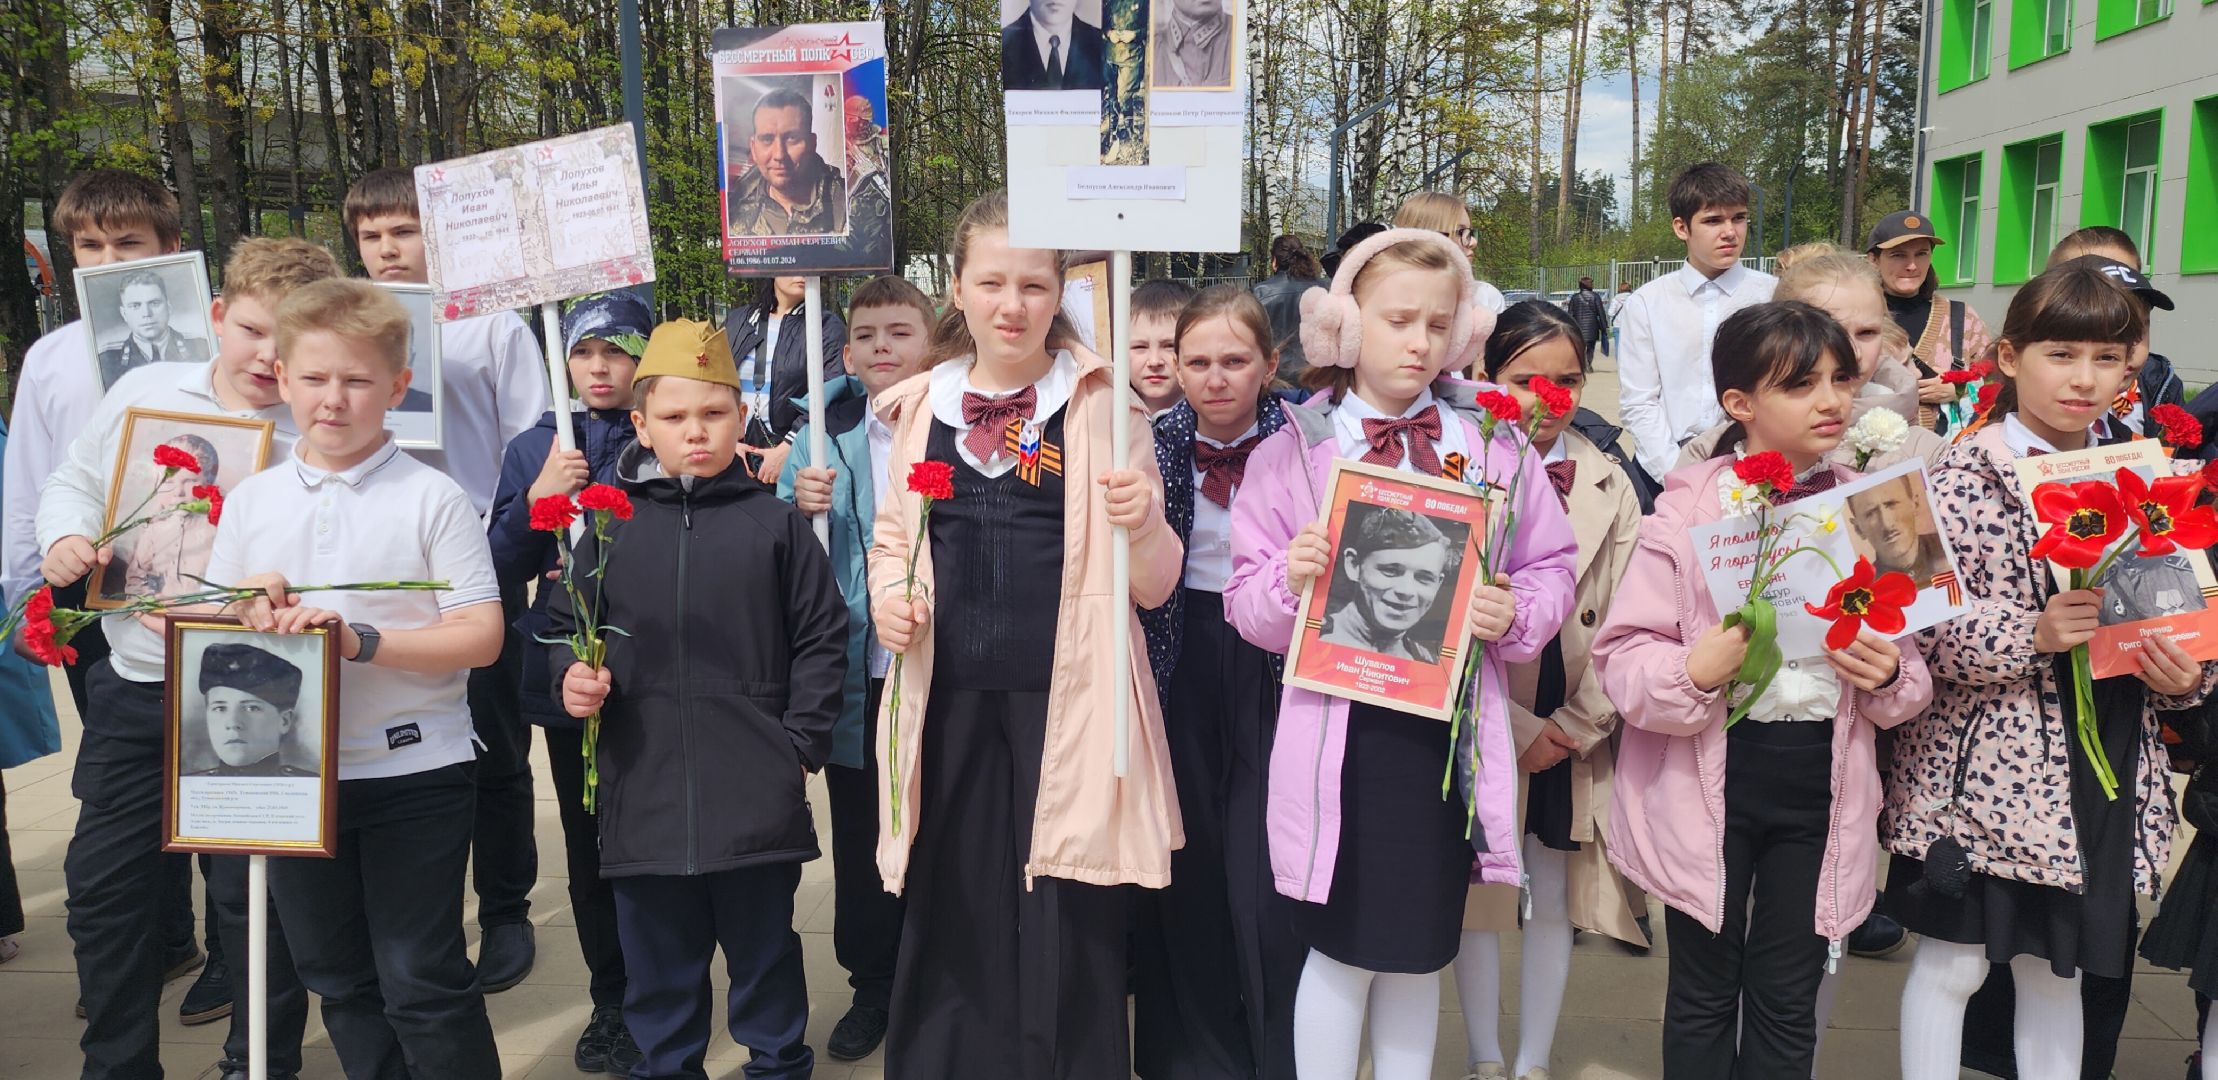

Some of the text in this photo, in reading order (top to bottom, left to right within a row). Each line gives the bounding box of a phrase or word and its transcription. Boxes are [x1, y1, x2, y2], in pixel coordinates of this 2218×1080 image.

[719, 47, 874, 64] БЕССМЕРТНЫЙ ПОЛК СВО
[560, 165, 605, 181] Лопухов
[571, 180, 598, 192] Илья
[451, 187, 495, 203] Лопухов
[556, 189, 619, 209] Николаевич
[462, 203, 488, 215] Иван
[446, 211, 508, 232] Николаевич
[728, 237, 847, 248] ЛОПУХОВ РОМАН СЕРГЕЕВИЧ
[728, 248, 767, 257] СЕРЖАНТ
[2104, 451, 2144, 465] 80 ПОБЕДА!
[1425, 498, 1468, 514] 80 ПОБЕДА!
[1709, 534, 1720, 550] Я
[1710, 556, 1721, 571] Я
[1355, 656, 1396, 672] Шувалов
[1336, 662, 1410, 685] Иван Никитович
